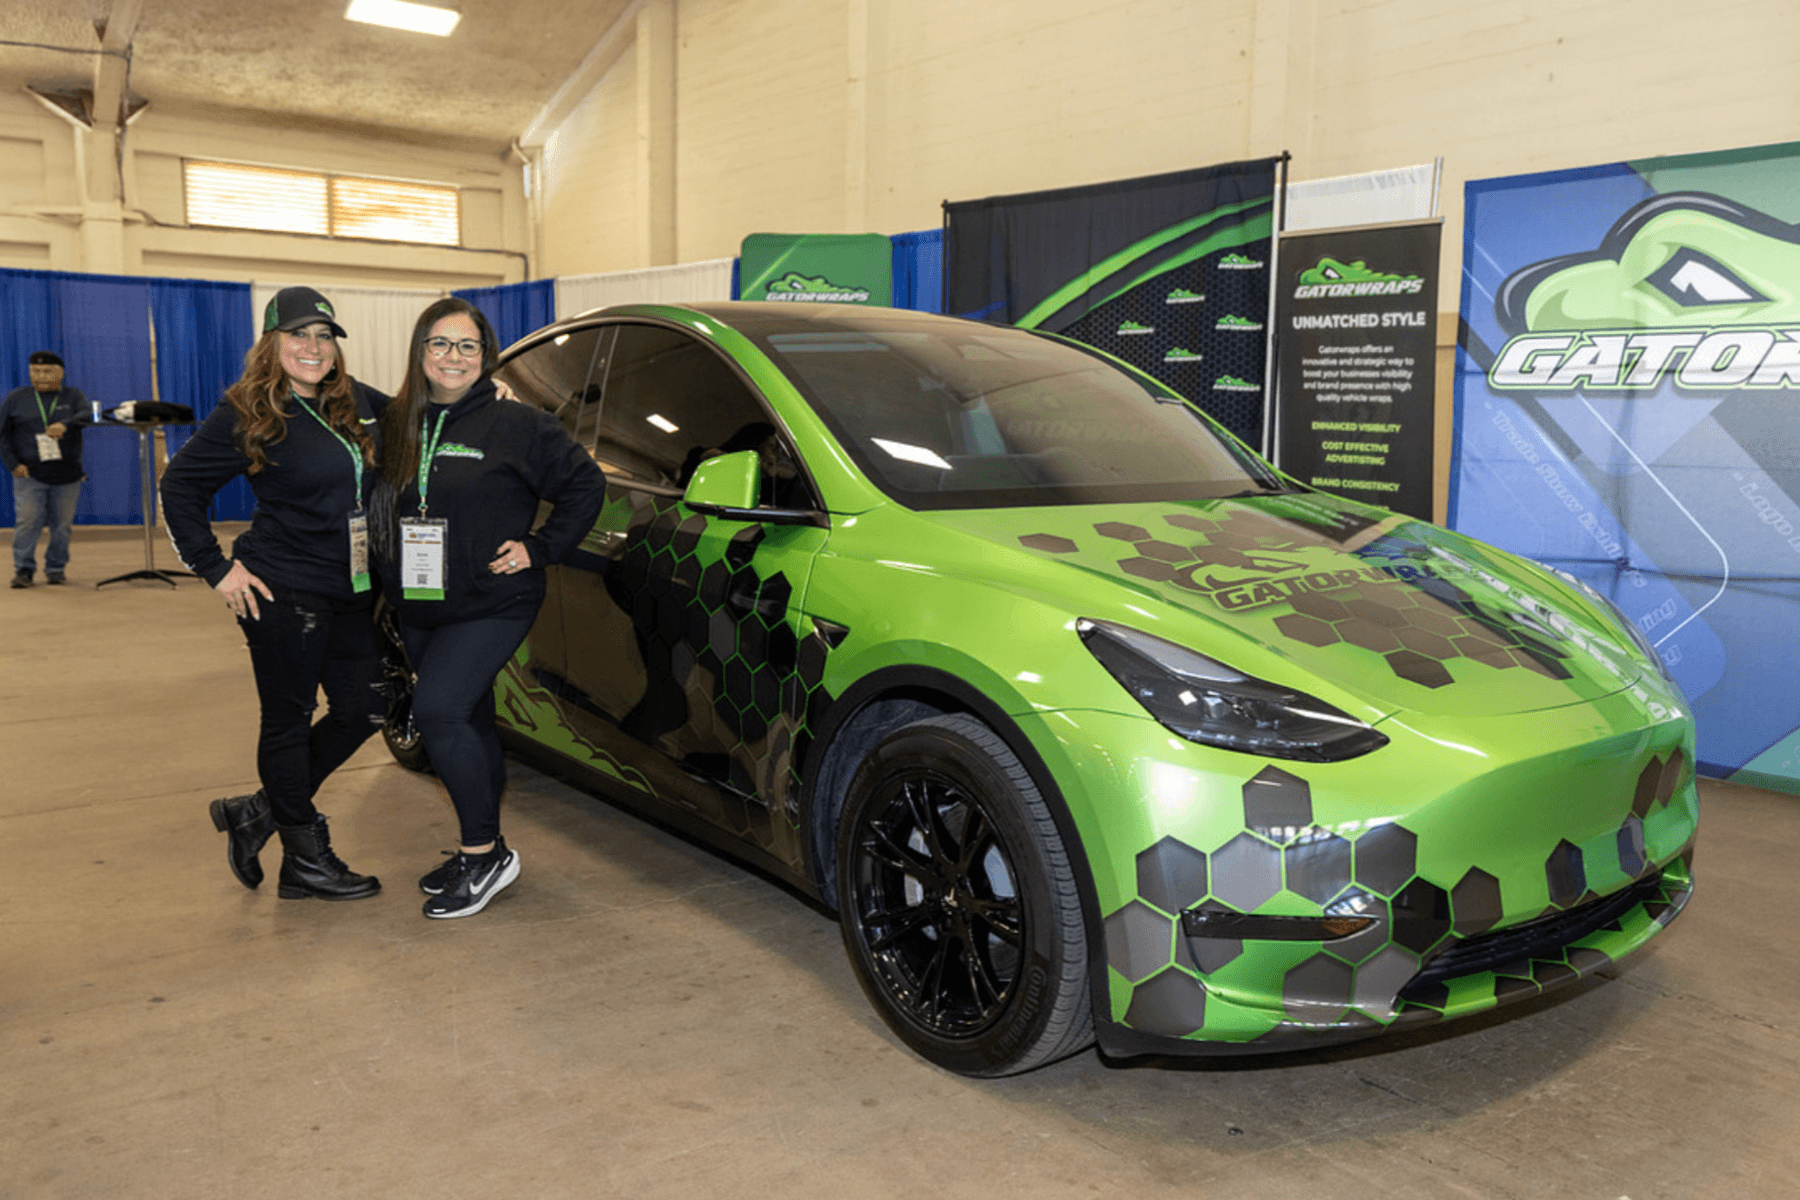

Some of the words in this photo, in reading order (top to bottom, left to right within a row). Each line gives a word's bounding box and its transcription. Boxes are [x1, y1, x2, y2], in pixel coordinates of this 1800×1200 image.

[1294, 278, 1425, 299] GATORWRAPS
[766, 291, 870, 302] GATORWRAPS
[1292, 313, 1379, 330] UNMATCHED
[1381, 310, 1427, 327] STYLE
[1384, 345, 1394, 353] an
[1338, 357, 1352, 366] and
[1353, 357, 1386, 368] strategic
[1387, 359, 1403, 368] way
[1405, 357, 1415, 366] to
[1322, 371, 1339, 380] your
[1317, 381, 1339, 390] brand
[1374, 381, 1391, 390] with
[1392, 381, 1412, 393] high
[1342, 394, 1367, 402] vehicle
[1311, 421, 1358, 432] ENHANCED
[1359, 422, 1402, 434] VISIBILITY
[1322, 441, 1343, 451] COST
[1345, 441, 1390, 454] EFFECTIVE
[1311, 477, 1340, 488] BRAND
[1341, 478, 1401, 492] CONSISTENCY
[1739, 481, 1794, 535] Logo
